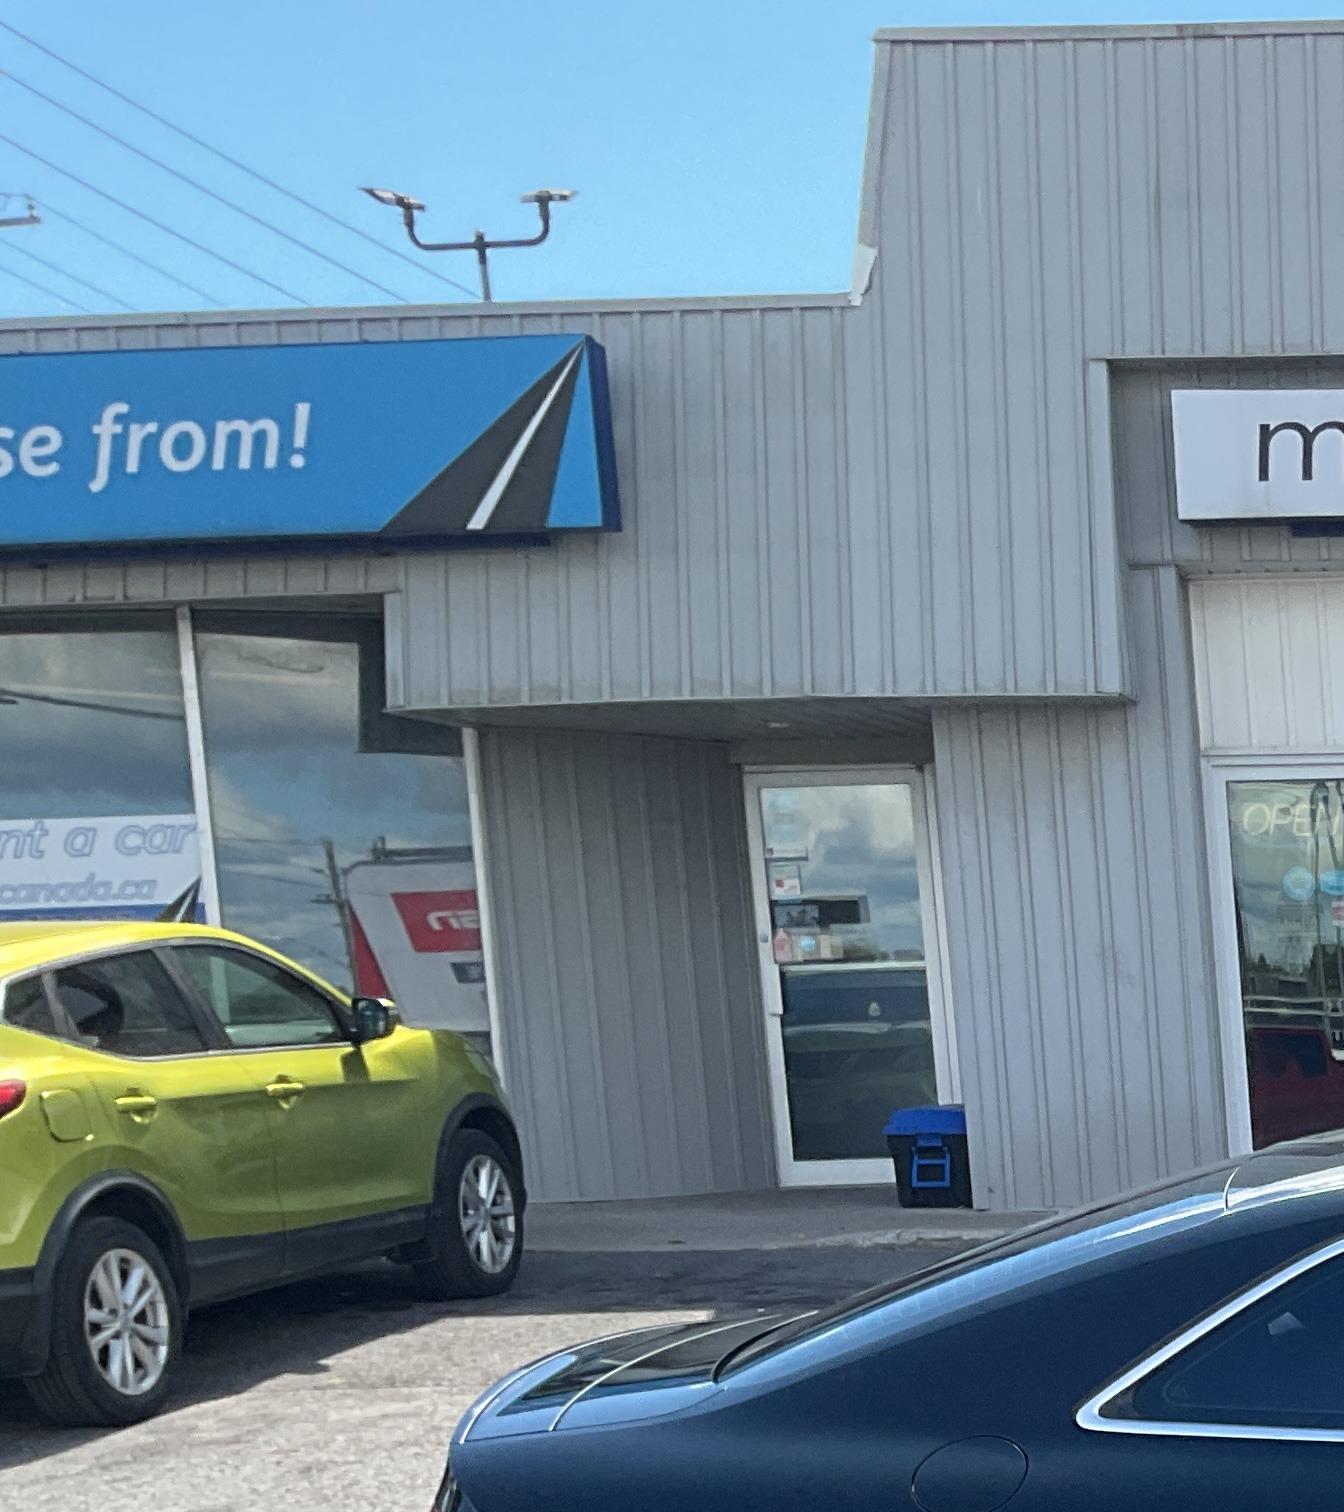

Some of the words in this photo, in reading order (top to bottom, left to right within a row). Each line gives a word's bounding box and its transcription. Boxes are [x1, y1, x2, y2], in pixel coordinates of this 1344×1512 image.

[87, 401, 312, 494] from!
[1243, 801, 1341, 837] OPEN
[64, 826, 98, 858] a
[114, 823, 198, 857] car
